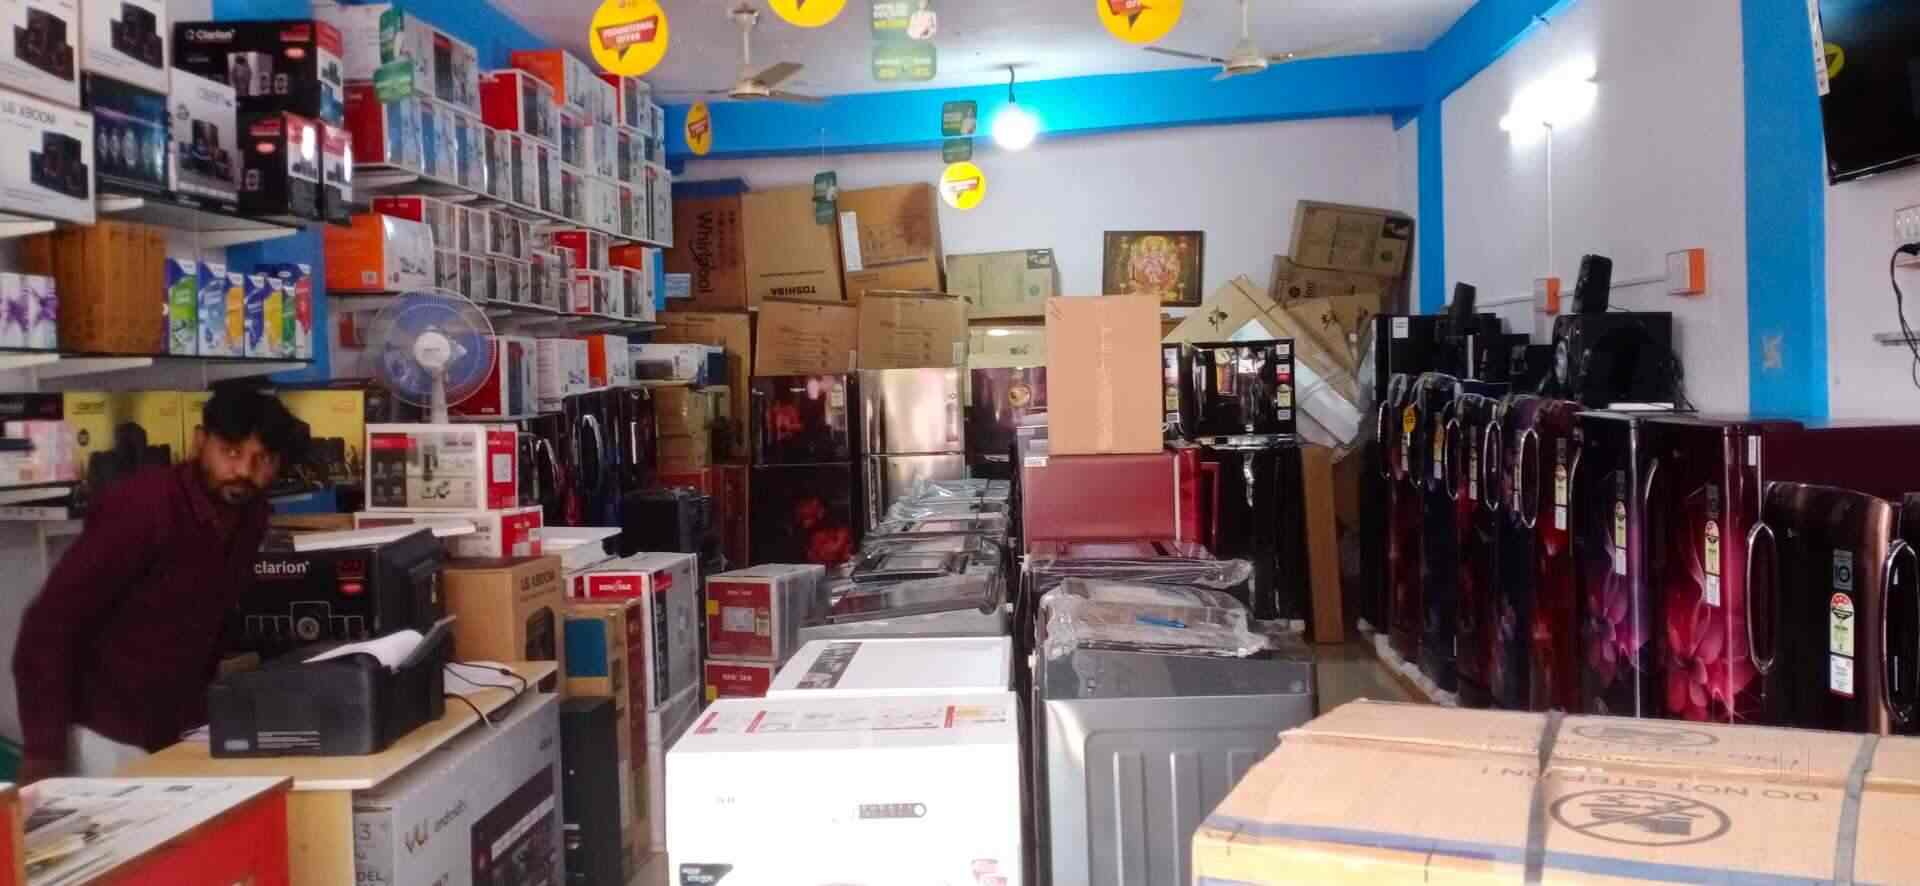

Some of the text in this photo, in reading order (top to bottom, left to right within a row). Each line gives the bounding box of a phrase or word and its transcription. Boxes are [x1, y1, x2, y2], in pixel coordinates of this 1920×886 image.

[769, 285, 817, 297] TOSHIBA
[255, 560, 307, 575] clarion
[1675, 782, 1749, 798] NOT
[1762, 789, 1819, 802] DO
